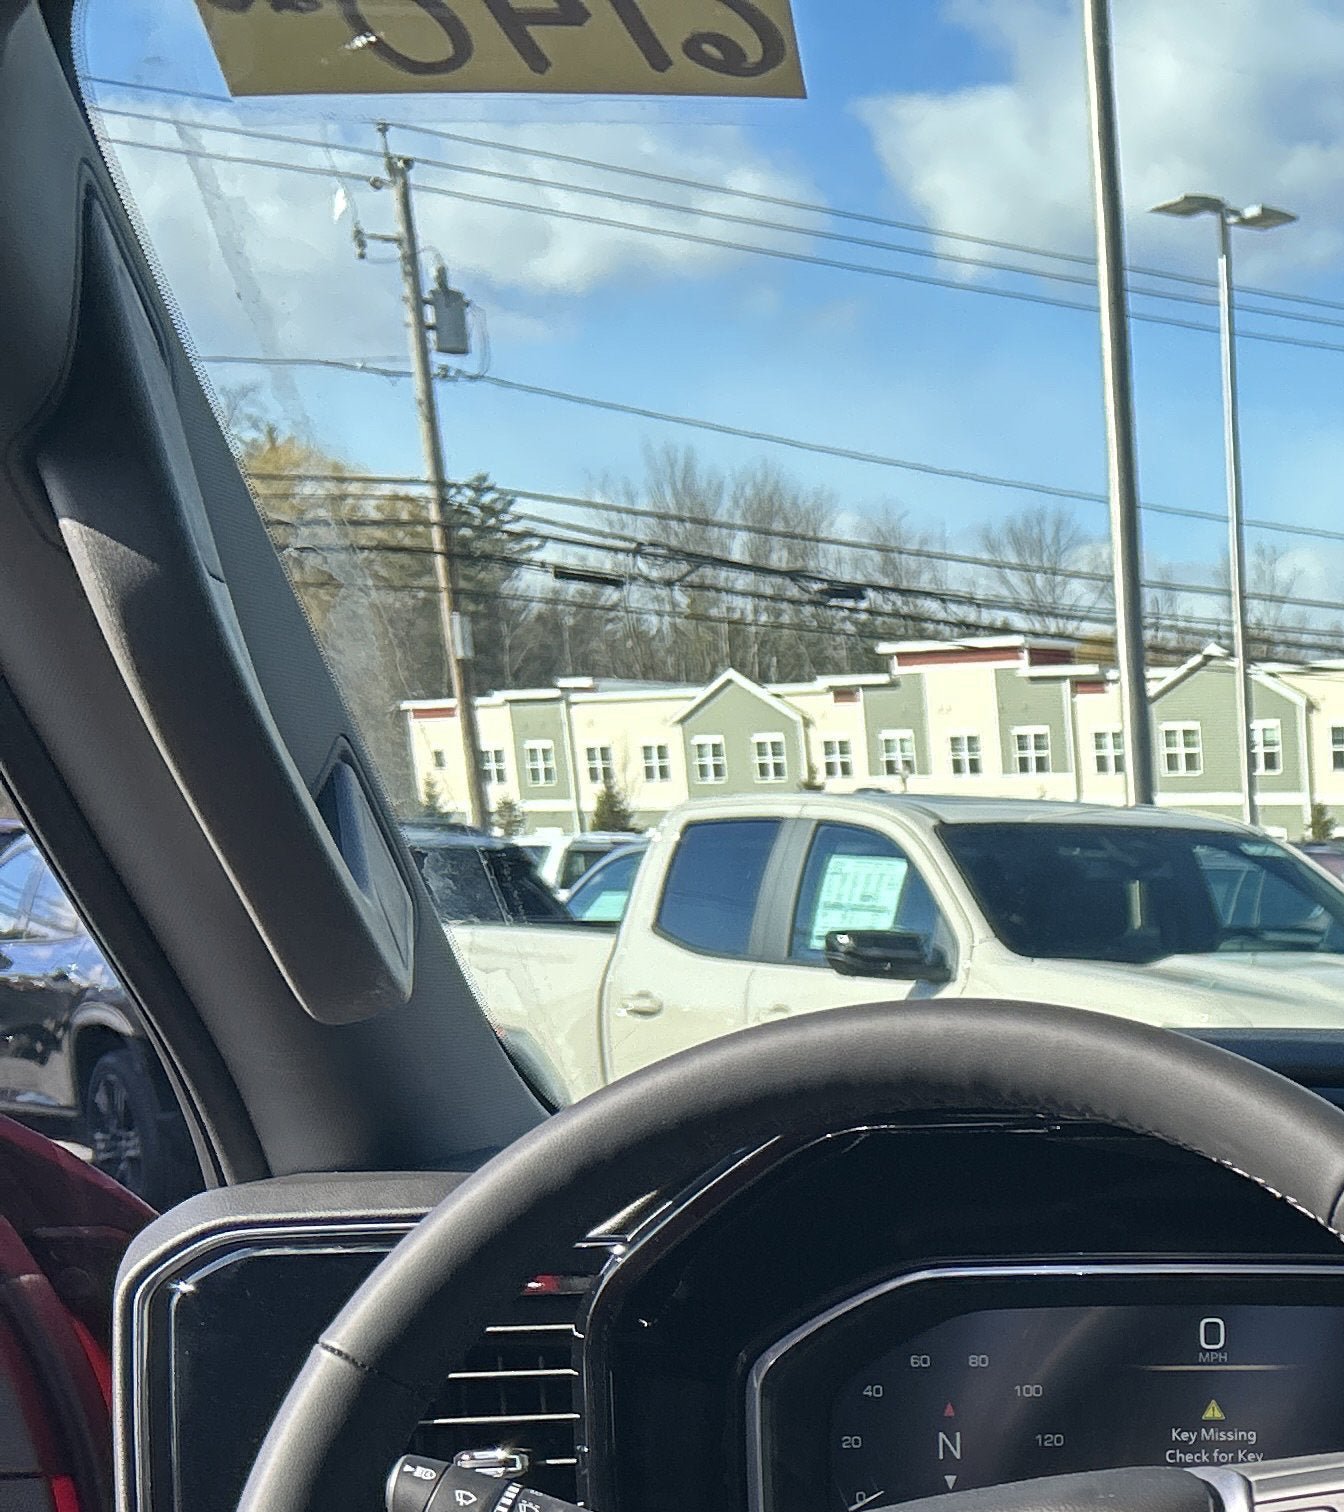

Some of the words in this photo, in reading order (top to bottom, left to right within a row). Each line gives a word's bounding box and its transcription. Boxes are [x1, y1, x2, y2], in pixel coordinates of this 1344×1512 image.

[1199, 1317, 1226, 1350] 0
[910, 1355, 931, 1368] 60
[968, 1355, 989, 1368] 80
[1198, 1352, 1227, 1363] MPH
[862, 1385, 883, 1398] 40
[1014, 1385, 1043, 1397] 100
[841, 1436, 862, 1448] 20
[1036, 1435, 1064, 1447] 120
[1171, 1428, 1197, 1443] Key
[1201, 1428, 1257, 1443] Missing
[938, 1432, 961, 1460] N
[1166, 1450, 1209, 1464] Check
[1213, 1449, 1234, 1463] for
[1238, 1450, 1264, 1463] Key
